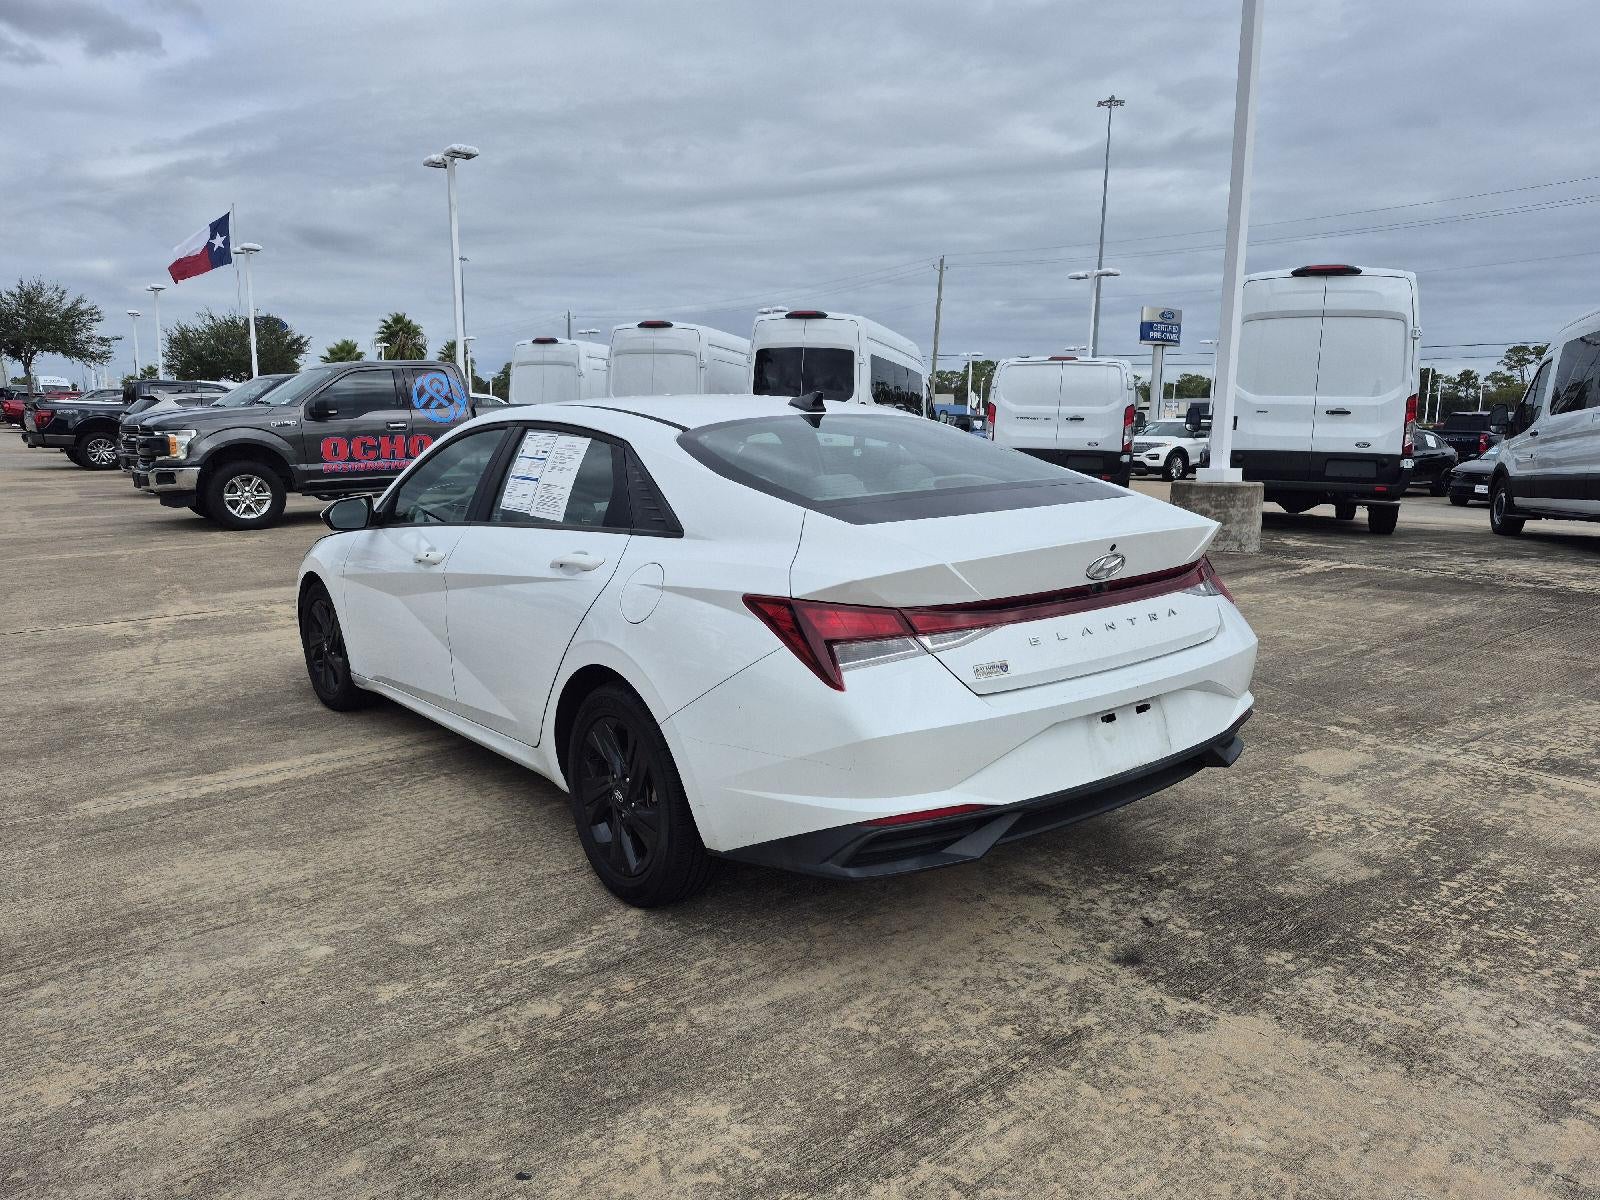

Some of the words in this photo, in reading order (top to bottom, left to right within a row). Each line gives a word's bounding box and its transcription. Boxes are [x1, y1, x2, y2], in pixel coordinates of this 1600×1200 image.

[1152, 324, 1179, 333] CERTIFIED
[321, 434, 433, 462] OCHO
[1028, 608, 1177, 646] ELANTRA
